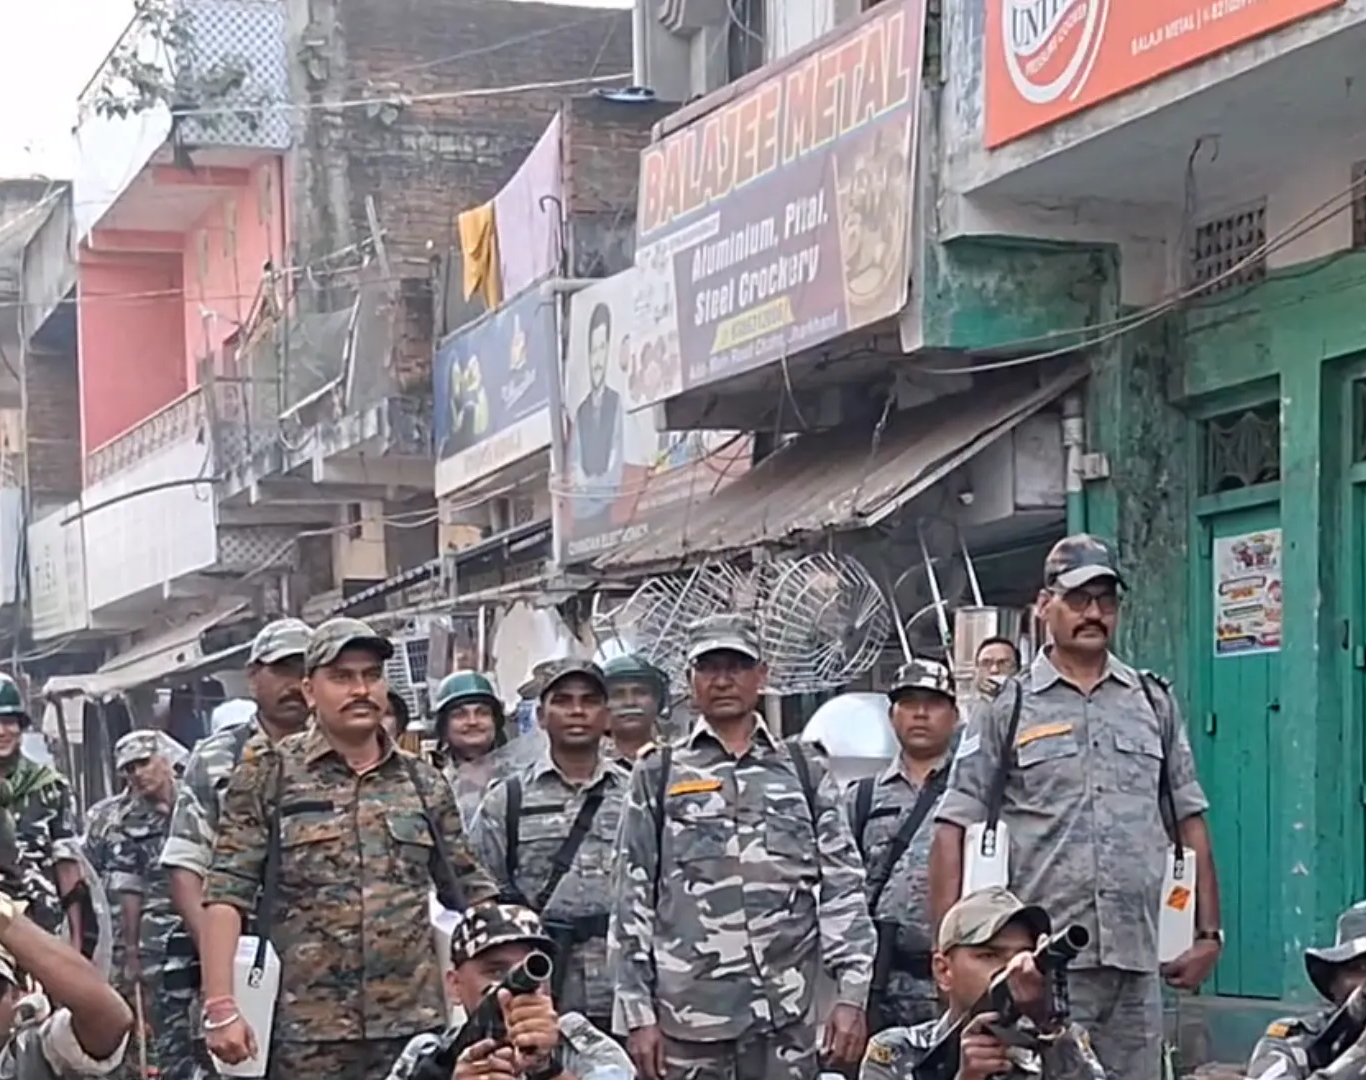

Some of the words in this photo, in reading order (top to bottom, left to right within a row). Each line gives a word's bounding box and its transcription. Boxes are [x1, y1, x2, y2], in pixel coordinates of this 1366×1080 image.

[641, 80, 782, 236] BALAJEE
[783, 10, 911, 165] METAL
[694, 277, 734, 327] Steel
[738, 244, 820, 309] Crockery
